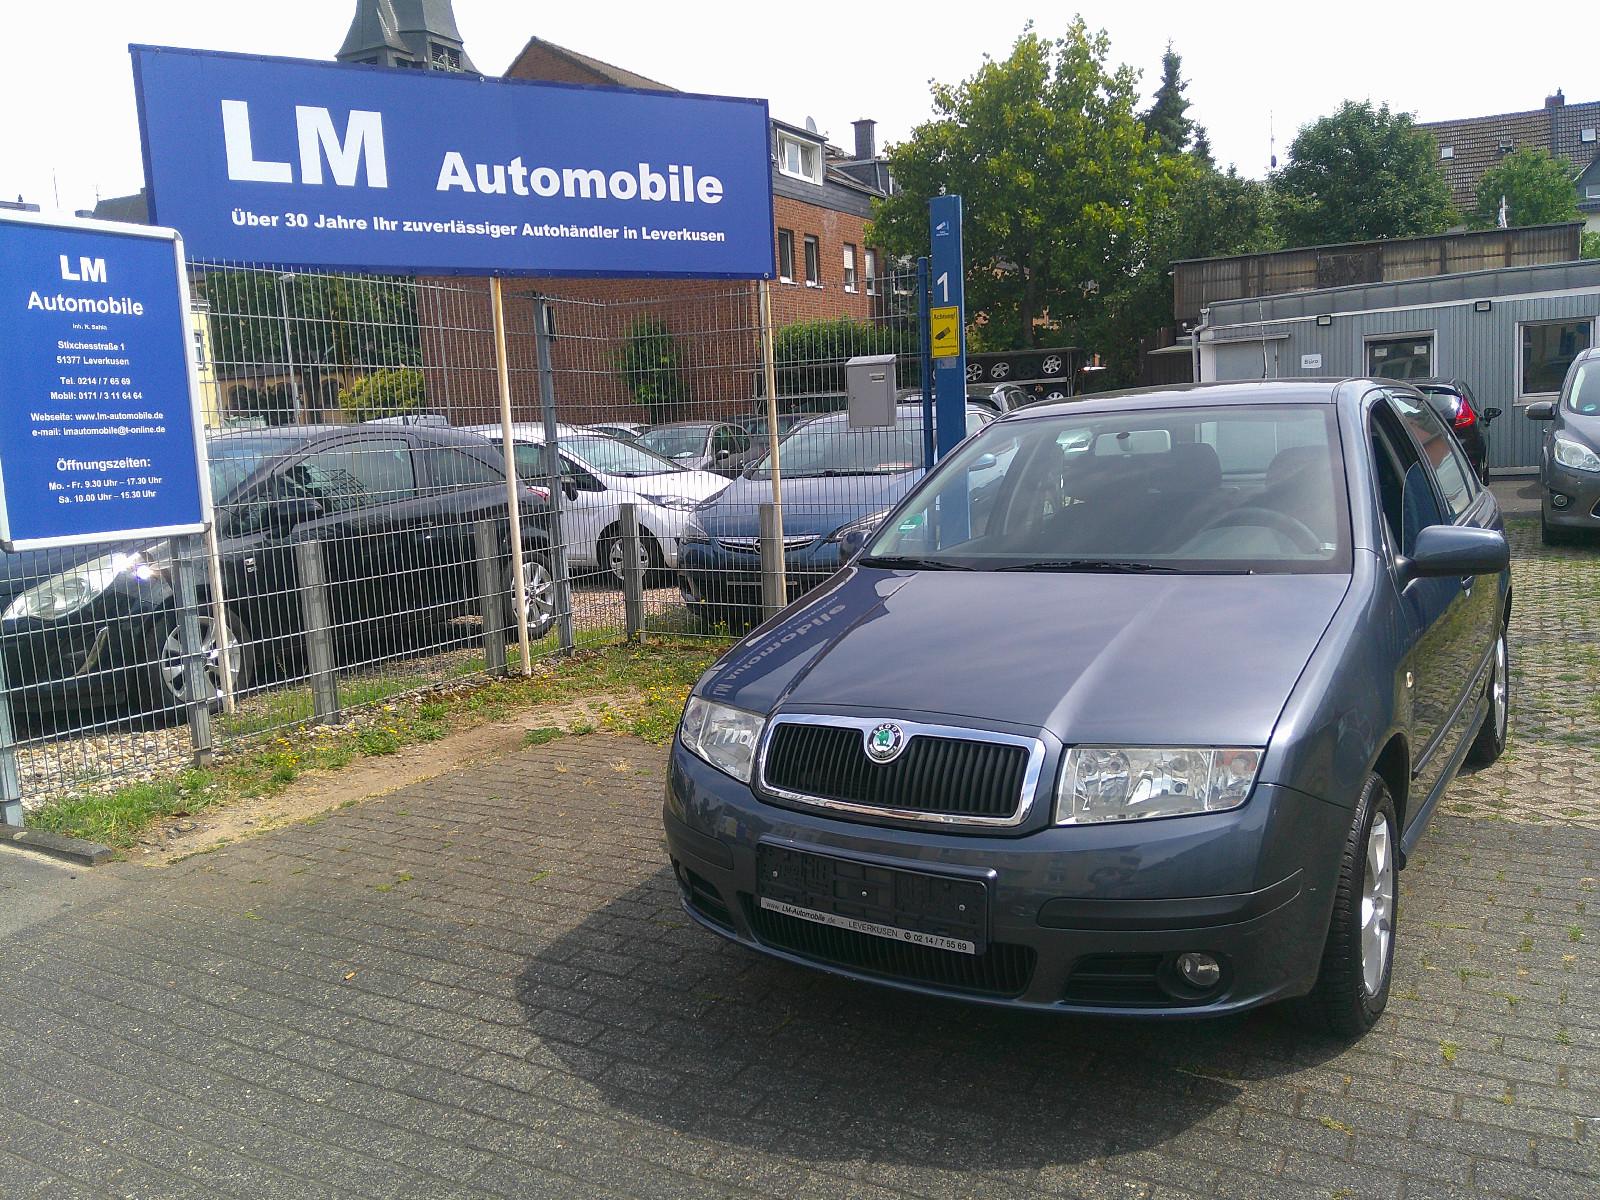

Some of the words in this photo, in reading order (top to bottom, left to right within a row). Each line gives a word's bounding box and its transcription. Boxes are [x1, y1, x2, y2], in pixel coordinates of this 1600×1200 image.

[221, 100, 388, 188] LM
[436, 152, 723, 203] Automobile
[232, 208, 279, 226] Über
[285, 213, 308, 227] 30
[314, 215, 367, 229] Jahre
[373, 217, 398, 230] Ihr
[403, 220, 517, 238] zuverlässiger
[522, 223, 619, 238] Autohändler
[624, 226, 637, 239] in
[642, 227, 724, 241] Leverkusen
[60, 255, 107, 283] LM
[937, 272, 948, 302] 1
[28, 291, 143, 315] Automobile
[58, 341, 118, 350] Stixchesstraße
[57, 356, 80, 364] 51377
[83, 357, 129, 365] Leverkusen
[31, 413, 73, 421] Webseite:
[75, 412, 163, 420] www.lm-automobile.de
[32, 428, 61, 436] e-mail:
[64, 426, 165, 435] lmautomobile@t-online.de
[57, 457, 150, 471] Öffnungszeiten:
[49, 482, 64, 490] Mo.
[85, 480, 101, 488] 9.30
[127, 477, 146, 485] 17.30
[74, 494, 95, 502] 10.00
[849, 922, 898, 937] LEVERKUSEN
[914, 934, 923, 942] 02
[925, 936, 933, 944] 14
[939, 938, 944, 946] 7
[957, 942, 967, 950] 69
